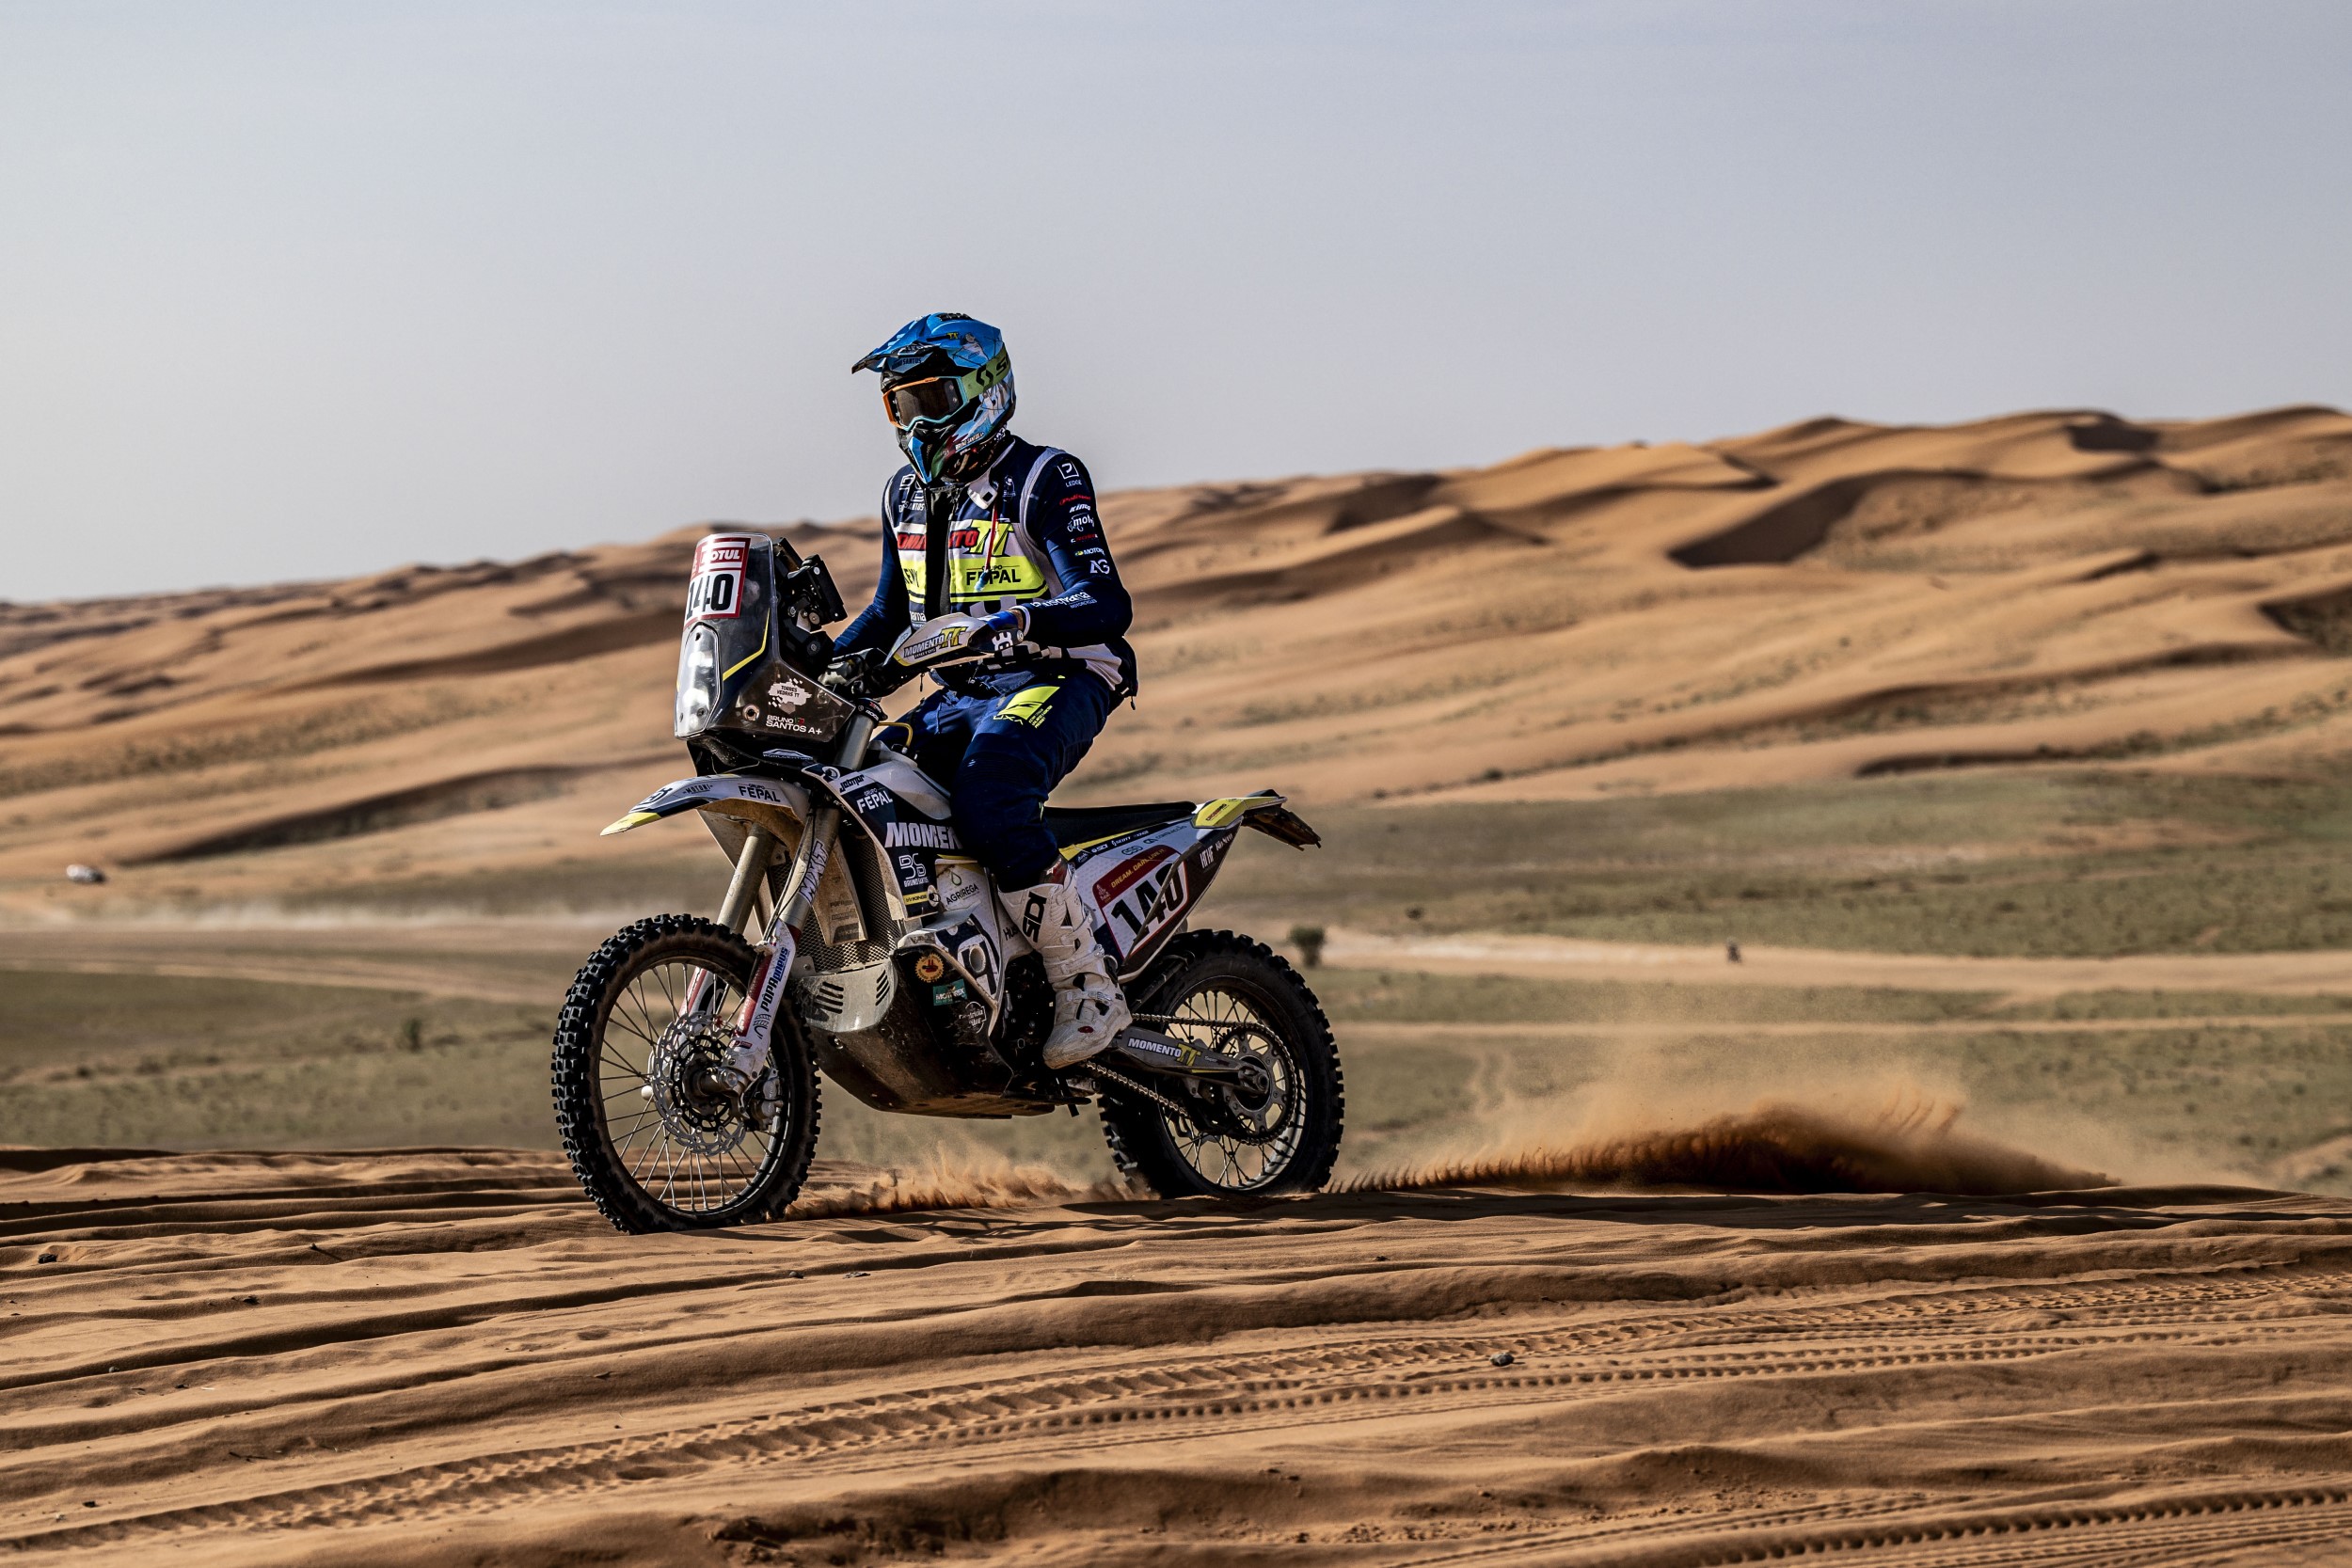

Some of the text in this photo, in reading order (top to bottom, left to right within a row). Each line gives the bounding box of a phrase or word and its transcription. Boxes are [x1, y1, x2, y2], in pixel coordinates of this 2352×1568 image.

[687, 574, 734, 620] 140
[904, 634, 945, 657] MOMENTO
[766, 720, 806, 732] SANTOS
[767, 715, 794, 723] BRUNO
[738, 785, 781, 802] FEPAL
[856, 790, 894, 814] FEPAL
[946, 883, 979, 905] AGRIREGA
[1111, 863, 1184, 942] 140
[1128, 1037, 1202, 1066] MOMENTO TT
